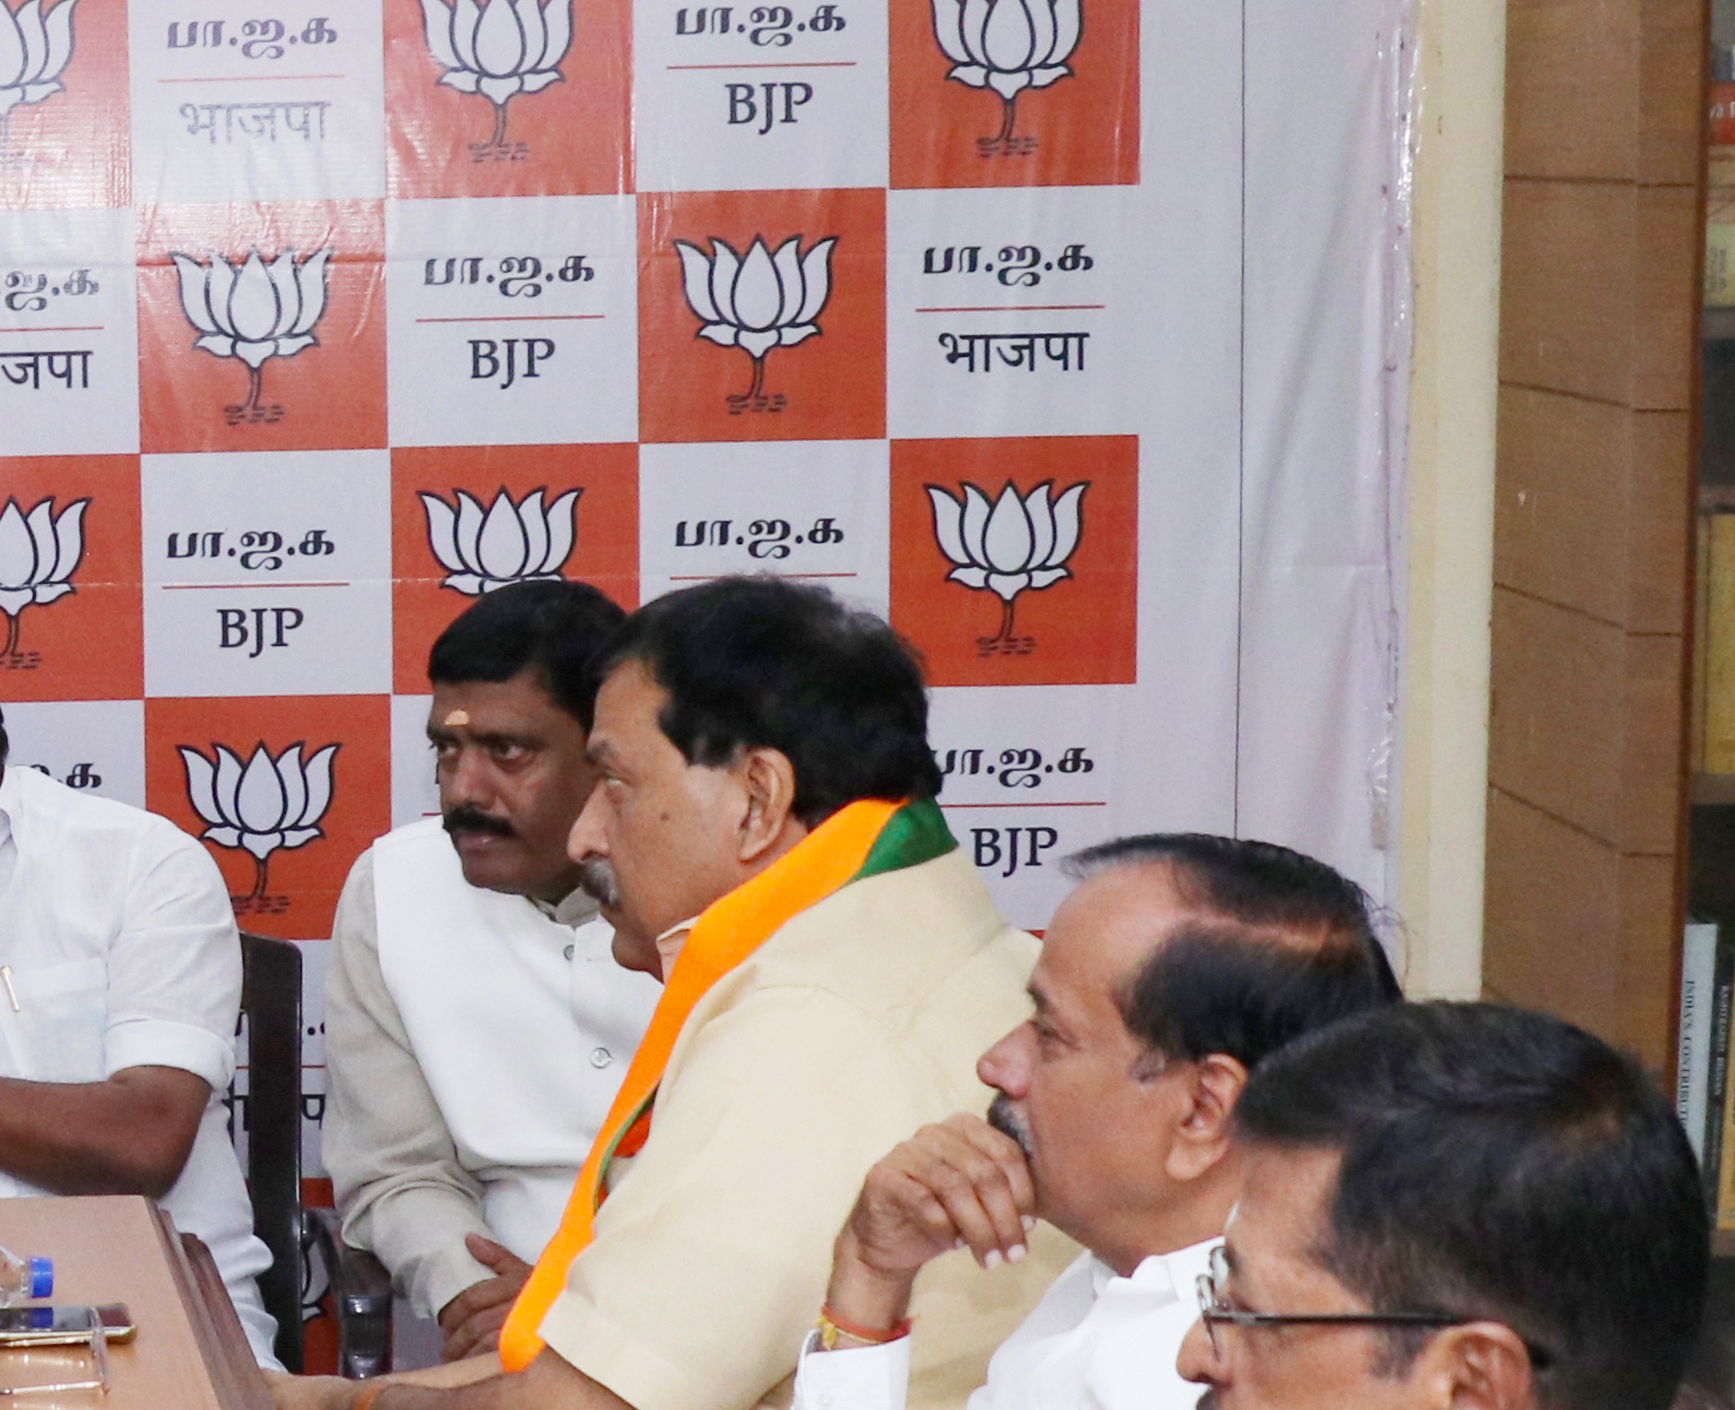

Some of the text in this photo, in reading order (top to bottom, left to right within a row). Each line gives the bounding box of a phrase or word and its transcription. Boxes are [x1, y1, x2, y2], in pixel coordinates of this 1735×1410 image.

[166, 16, 338, 60] பா.ஜ.க
[675, 4, 847, 48] பா.ஜ.க
[178, 100, 333, 145] भाजपा
[724, 81, 814, 136] BJP
[424, 254, 595, 299] பா.ஜ.க
[923, 244, 1094, 288] பா.ஜ.க
[467, 337, 556, 390] BJP
[937, 331, 1091, 374] भाजपा
[166, 529, 335, 571] பா.ஜ.க
[674, 517, 845, 560] பா.ஜ.க
[216, 607, 304, 659] BJP
[969, 826, 1058, 878] BJP
